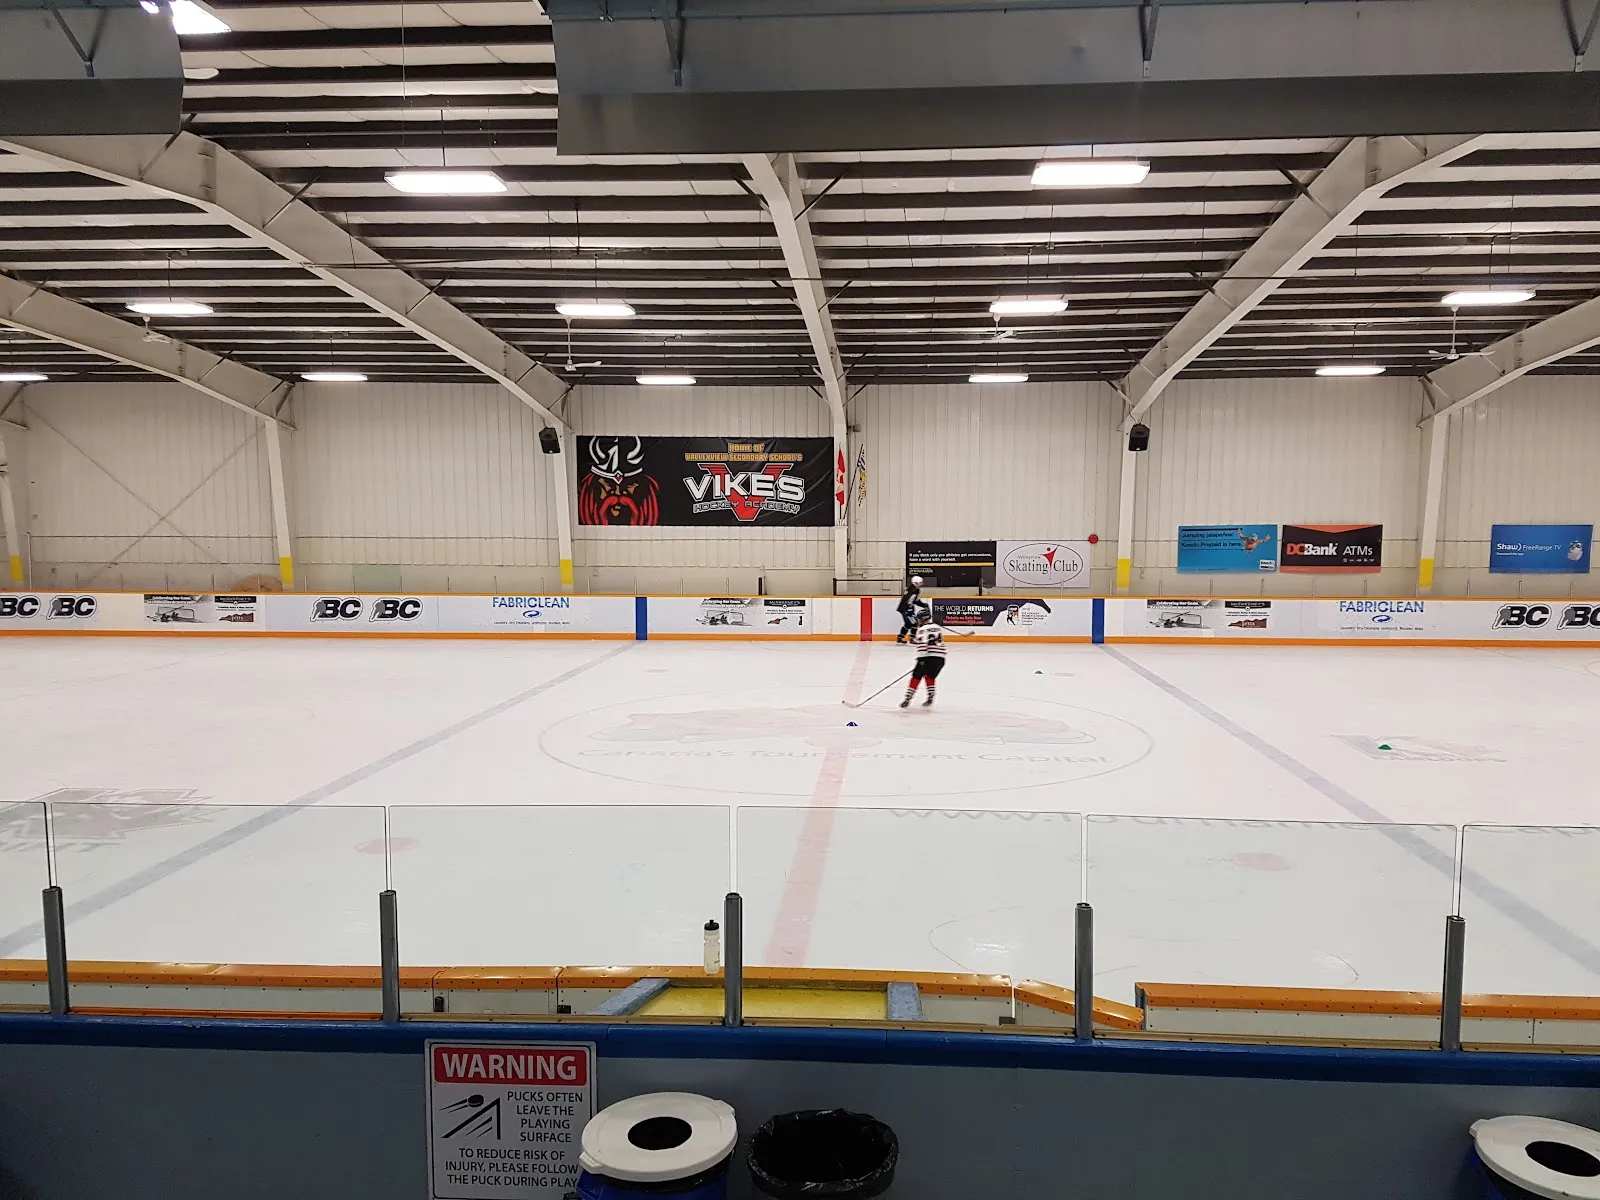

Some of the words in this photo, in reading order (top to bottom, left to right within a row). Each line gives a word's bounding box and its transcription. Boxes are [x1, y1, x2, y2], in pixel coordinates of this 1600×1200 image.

[729, 452, 768, 462] SECONDARY
[683, 472, 805, 503] VIKES
[692, 501, 740, 514] HOCKEY
[743, 500, 800, 515] ACADEMY
[1200, 540, 1222, 549] Prepaid
[1222, 540, 1228, 548] is
[1286, 542, 1338, 556] DCBank
[1342, 545, 1374, 556] ATMs
[1522, 544, 1553, 552] FreeRange
[1008, 559, 1049, 575] Skating
[1053, 559, 1079, 572] Club
[0, 597, 40, 617] BC
[52, 596, 96, 618] BC
[317, 598, 361, 619] BC
[376, 598, 422, 619] BC
[492, 597, 570, 608] FABRICLEAN
[1340, 600, 1424, 613] FABRICLEAN
[1500, 605, 1550, 626] BC
[577, 749, 735, 758] Canada's
[977, 753, 1111, 763] Capital
[441, 1053, 577, 1081] WARNING
[507, 1091, 543, 1102] PUCKS
[546, 1092, 583, 1103] OFTEN
[516, 1105, 550, 1116] LEAVE
[550, 1106, 574, 1116] THE
[520, 1119, 570, 1130] PLAYING
[520, 1132, 572, 1143] SURFACE
[459, 1148, 474, 1158] TO
[477, 1149, 521, 1159] REDUCE
[523, 1150, 548, 1160] RISK
[550, 1150, 566, 1161] OF
[445, 1161, 486, 1173] INJURY,
[488, 1163, 529, 1173] PLEASE
[531, 1163, 579, 1175] FOLLOW
[447, 1174, 469, 1185] THE
[471, 1175, 502, 1186] PUCK
[504, 1176, 548, 1188] DURING
[551, 1177, 578, 1188] PLAY
